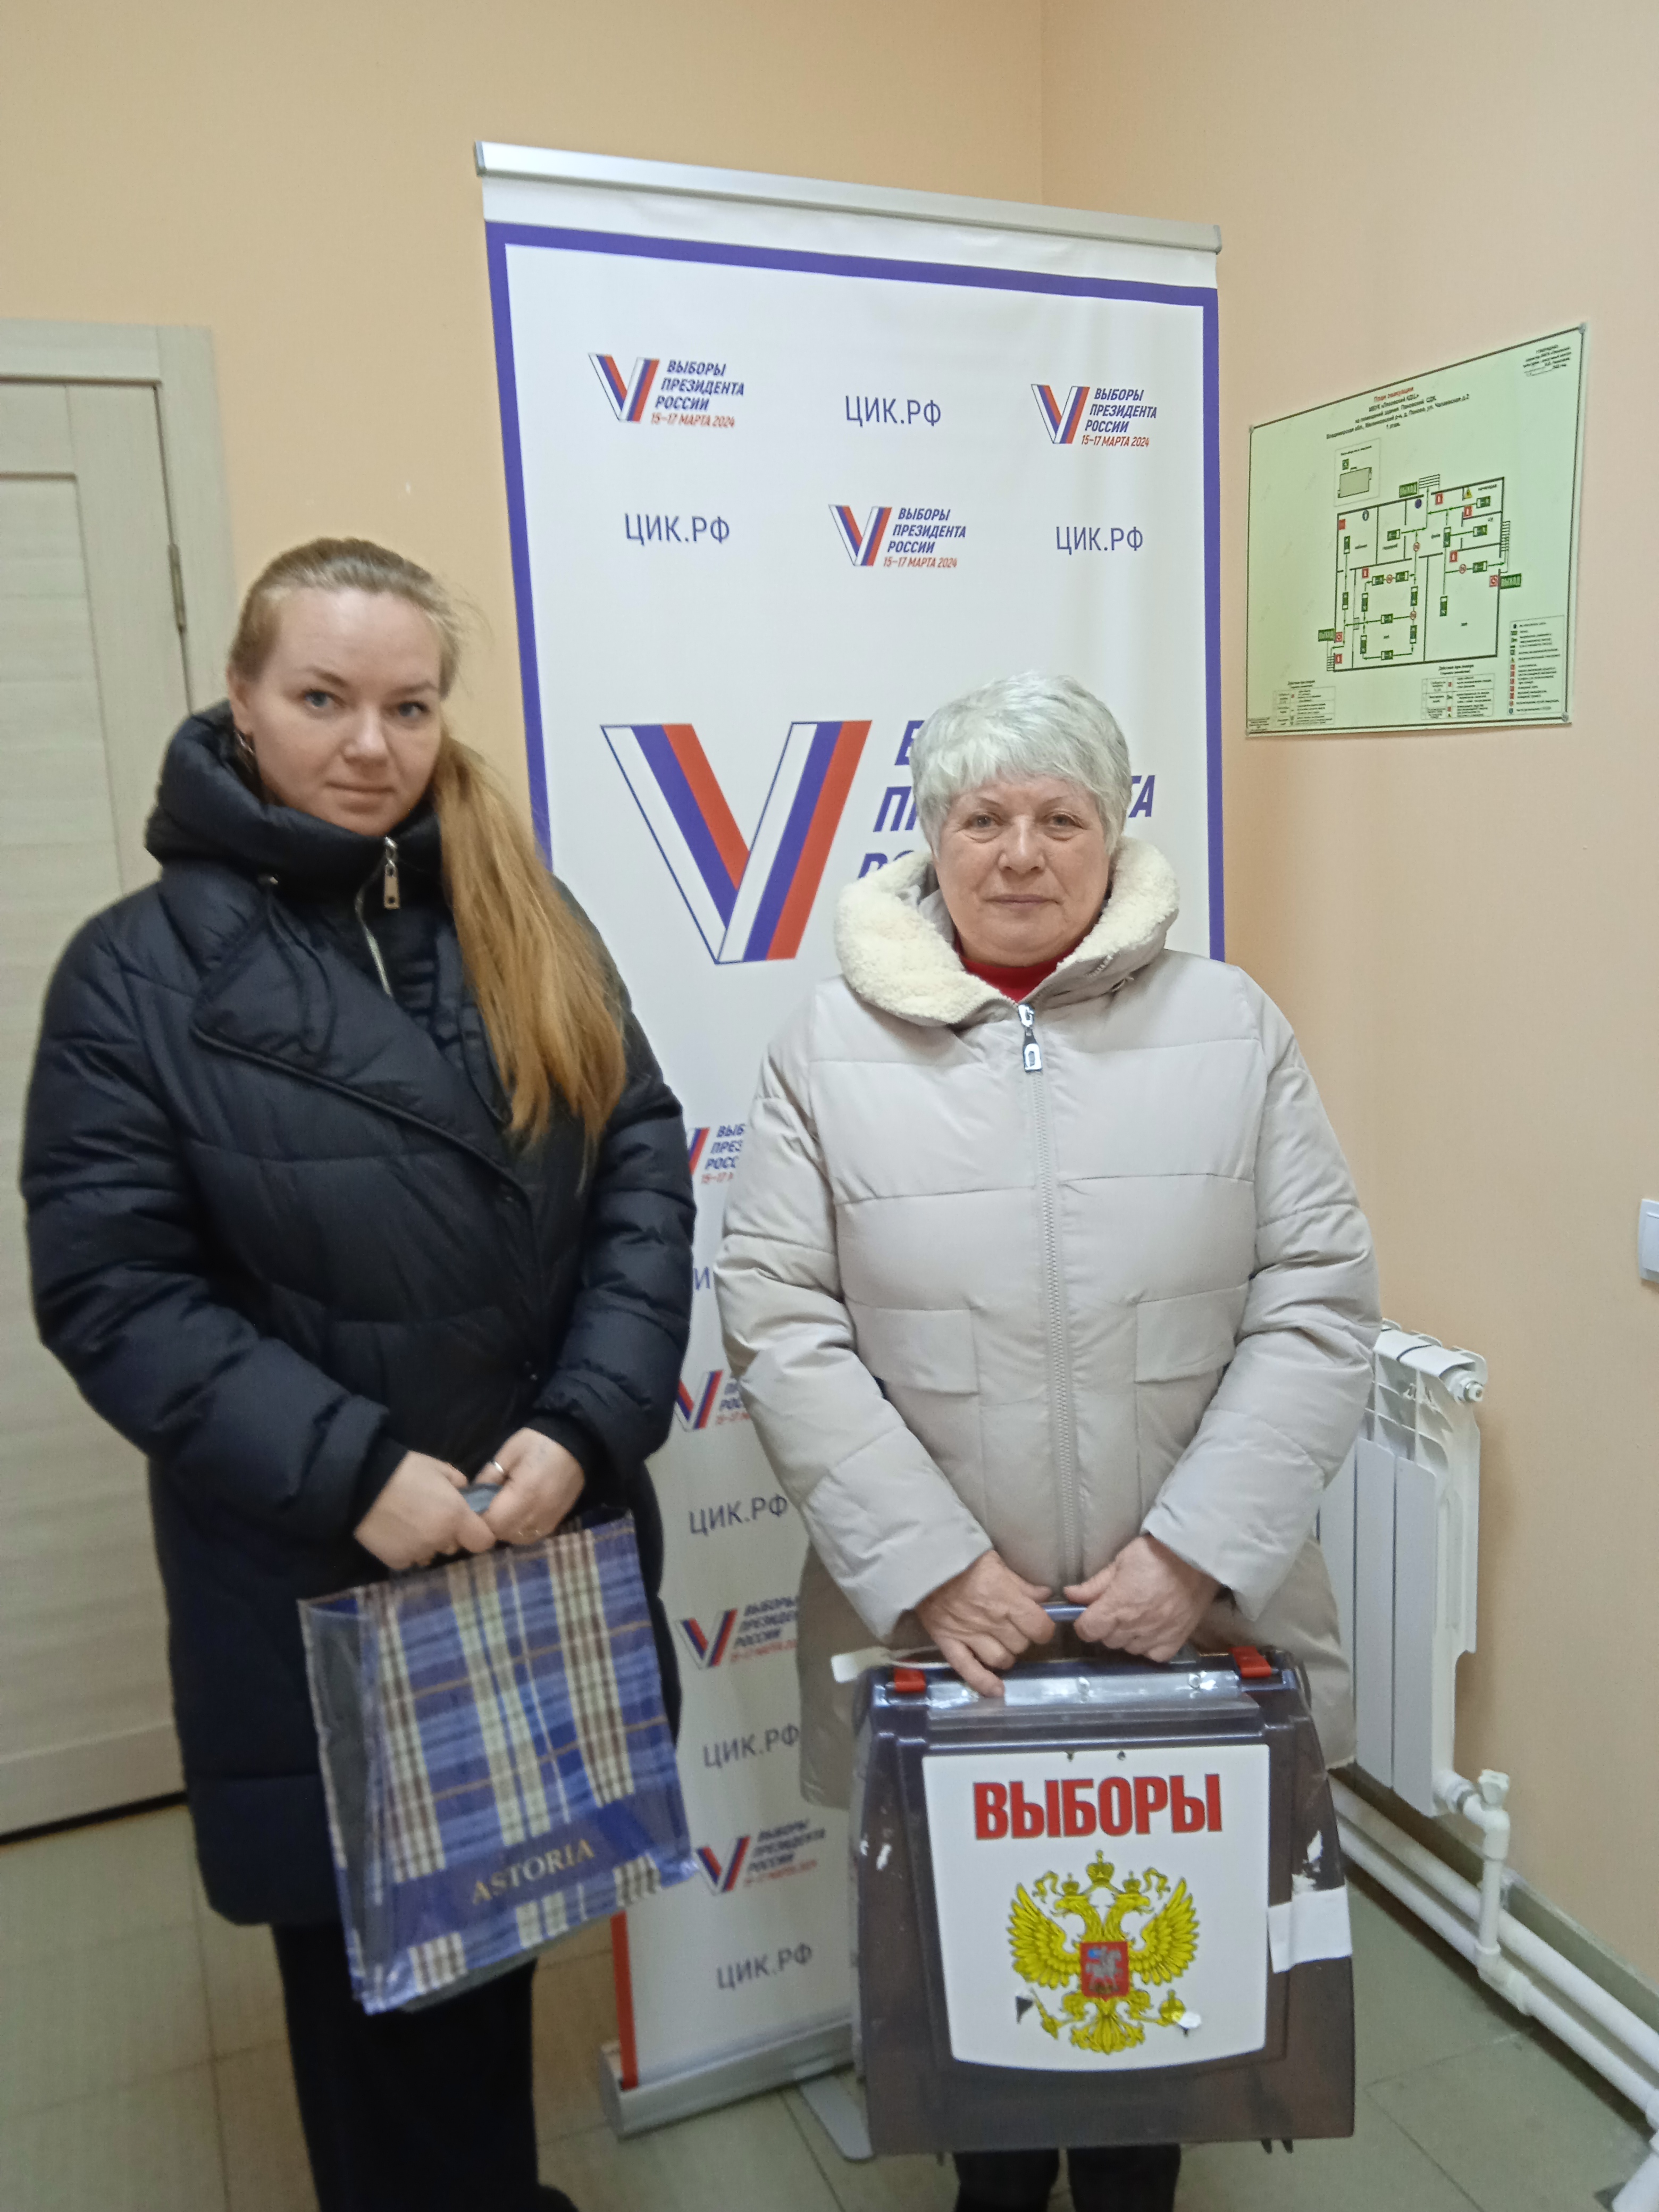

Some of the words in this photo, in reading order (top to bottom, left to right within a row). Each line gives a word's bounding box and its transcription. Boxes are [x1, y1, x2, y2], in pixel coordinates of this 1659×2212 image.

[666, 359, 726, 377] ВЫБОРЫ
[660, 378, 744, 397] ПРЕЗИДЕНТА
[1094, 388, 1144, 401] ВЫБОРЫ
[655, 395, 710, 411] РОССИИ
[845, 396, 942, 428] ЦИК.РФ
[1090, 404, 1158, 420] ПРЕЗИДЕНТА
[679, 414, 711, 427] МАРТА
[713, 415, 735, 429] 2024
[1085, 420, 1129, 433] РОССИИ
[1103, 435, 1129, 447] МАРТА
[1131, 437, 1149, 448] 2024
[898, 507, 951, 522] ВЫБОРЫ
[624, 512, 730, 547] ЦИК.РФ
[893, 524, 967, 539] ПРЕЗИДЕНТА
[887, 540, 935, 554] РОССИИ
[1056, 526, 1144, 556] ЦИК.РФ
[908, 556, 935, 568] МАРТА
[937, 557, 957, 568] 2024
[689, 1493, 787, 1537] ЦИК.РФ
[703, 1723, 800, 1769] ЦИК.РФ
[973, 1773, 1222, 1840] ВЫБОРЫ
[472, 1838, 594, 1905] ASTORIA
[716, 1942, 812, 1991] ЦИК.РФ
